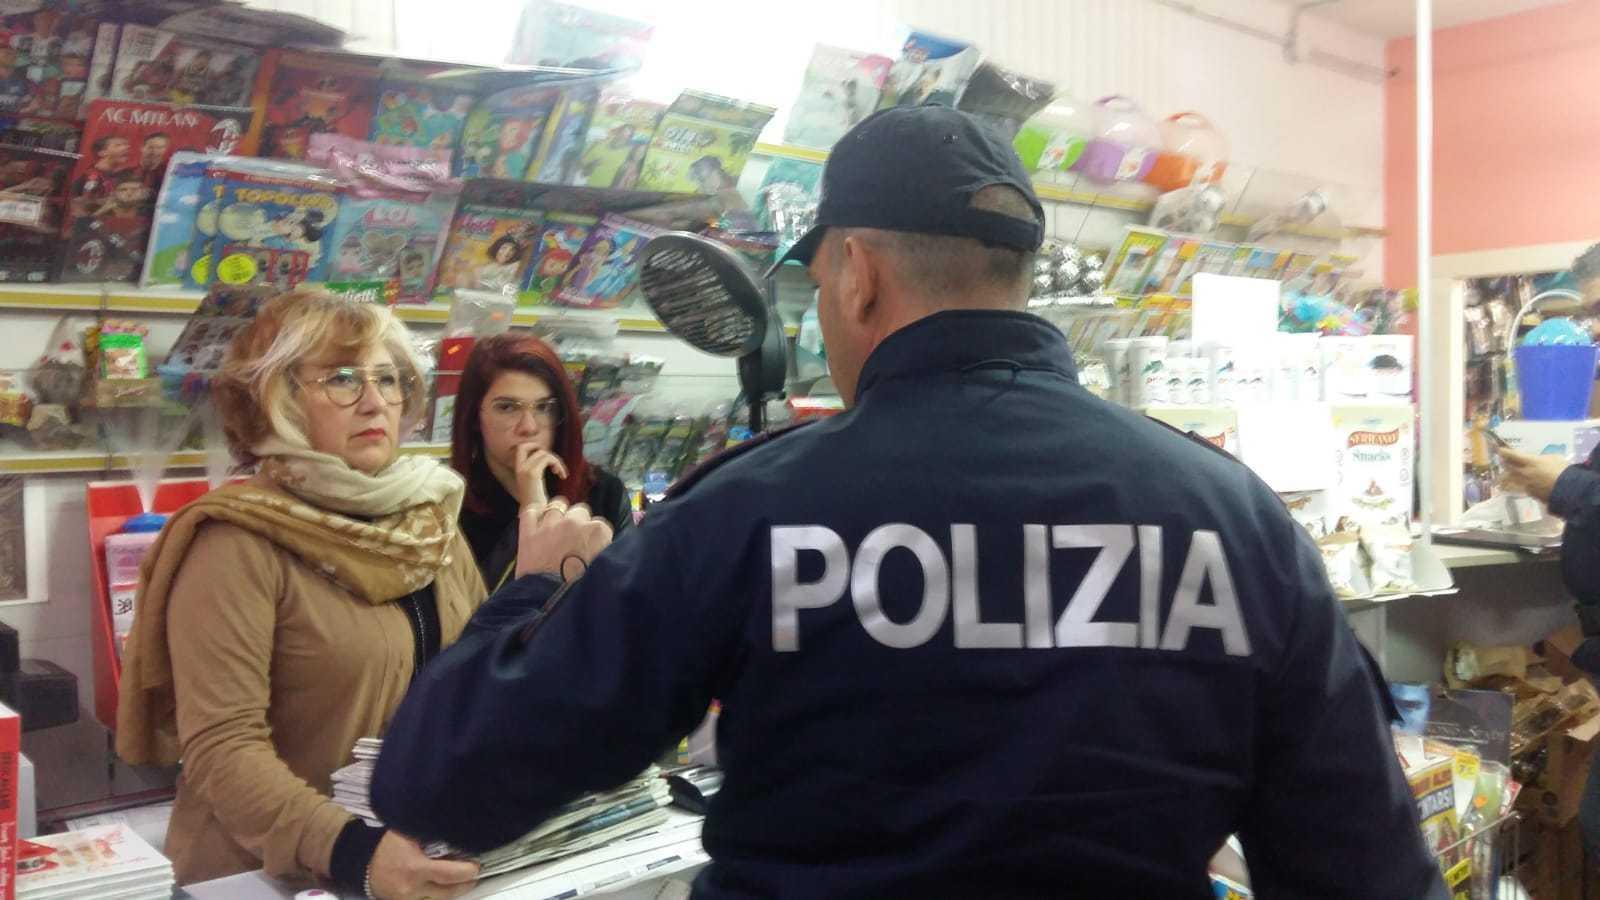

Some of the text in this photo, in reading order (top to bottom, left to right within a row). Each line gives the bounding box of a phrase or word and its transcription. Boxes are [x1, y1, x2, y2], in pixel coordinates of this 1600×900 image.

[98, 107, 198, 128] AC MILAN
[235, 187, 335, 210] TOPOLINO
[771, 523, 1252, 657] POLIZIA
